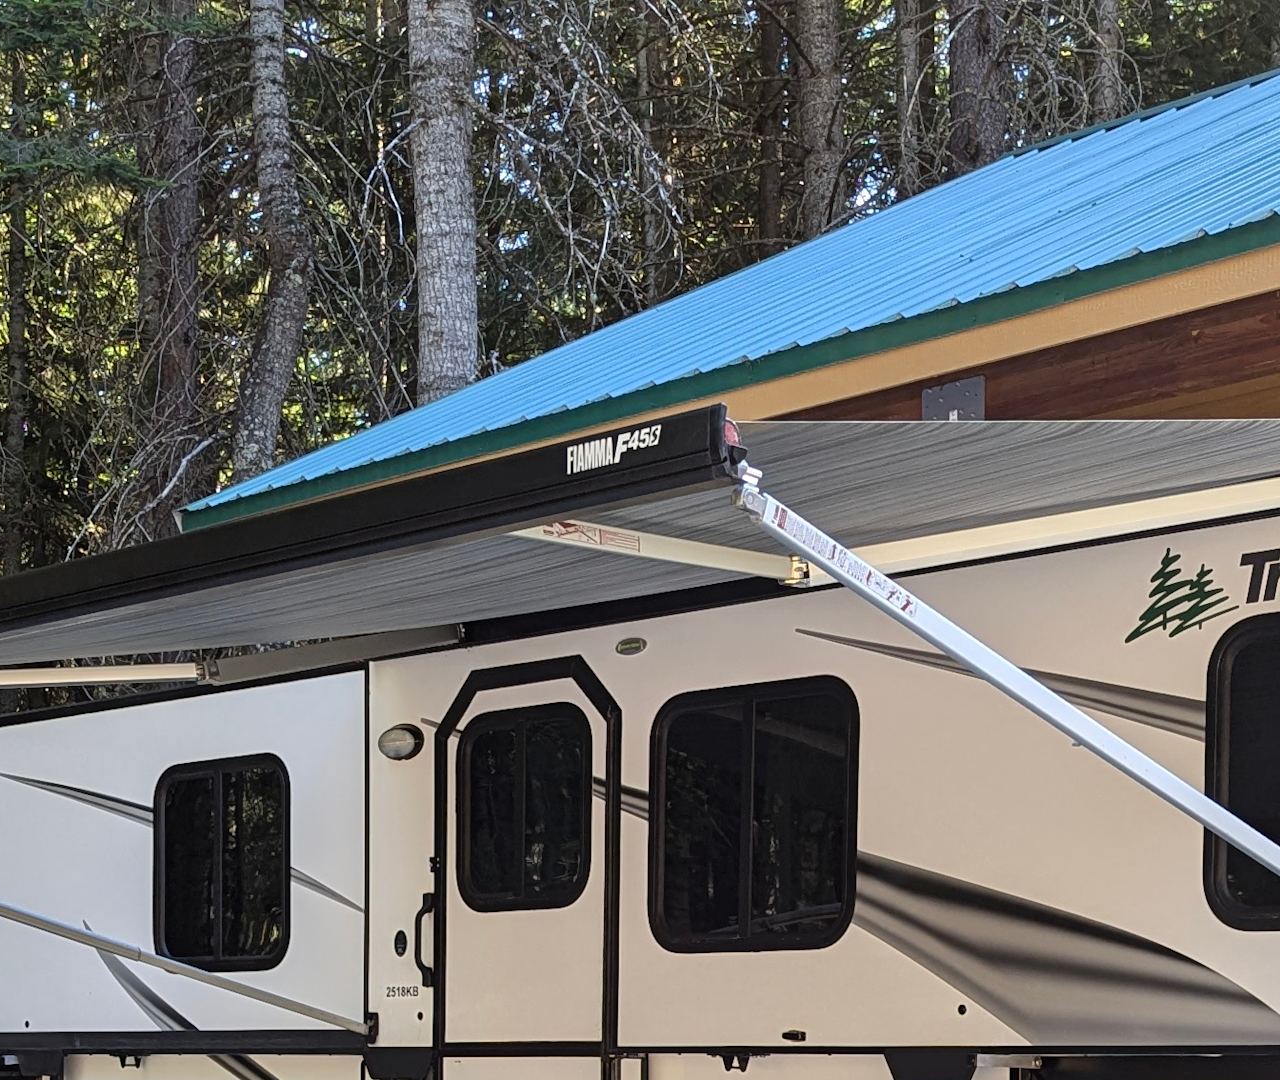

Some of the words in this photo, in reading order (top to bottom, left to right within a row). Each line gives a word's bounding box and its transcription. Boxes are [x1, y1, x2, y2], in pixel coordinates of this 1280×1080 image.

[567, 437, 614, 475] FIAMMA
[613, 424, 662, 464] F45S
[386, 985, 419, 998] 2518KB
